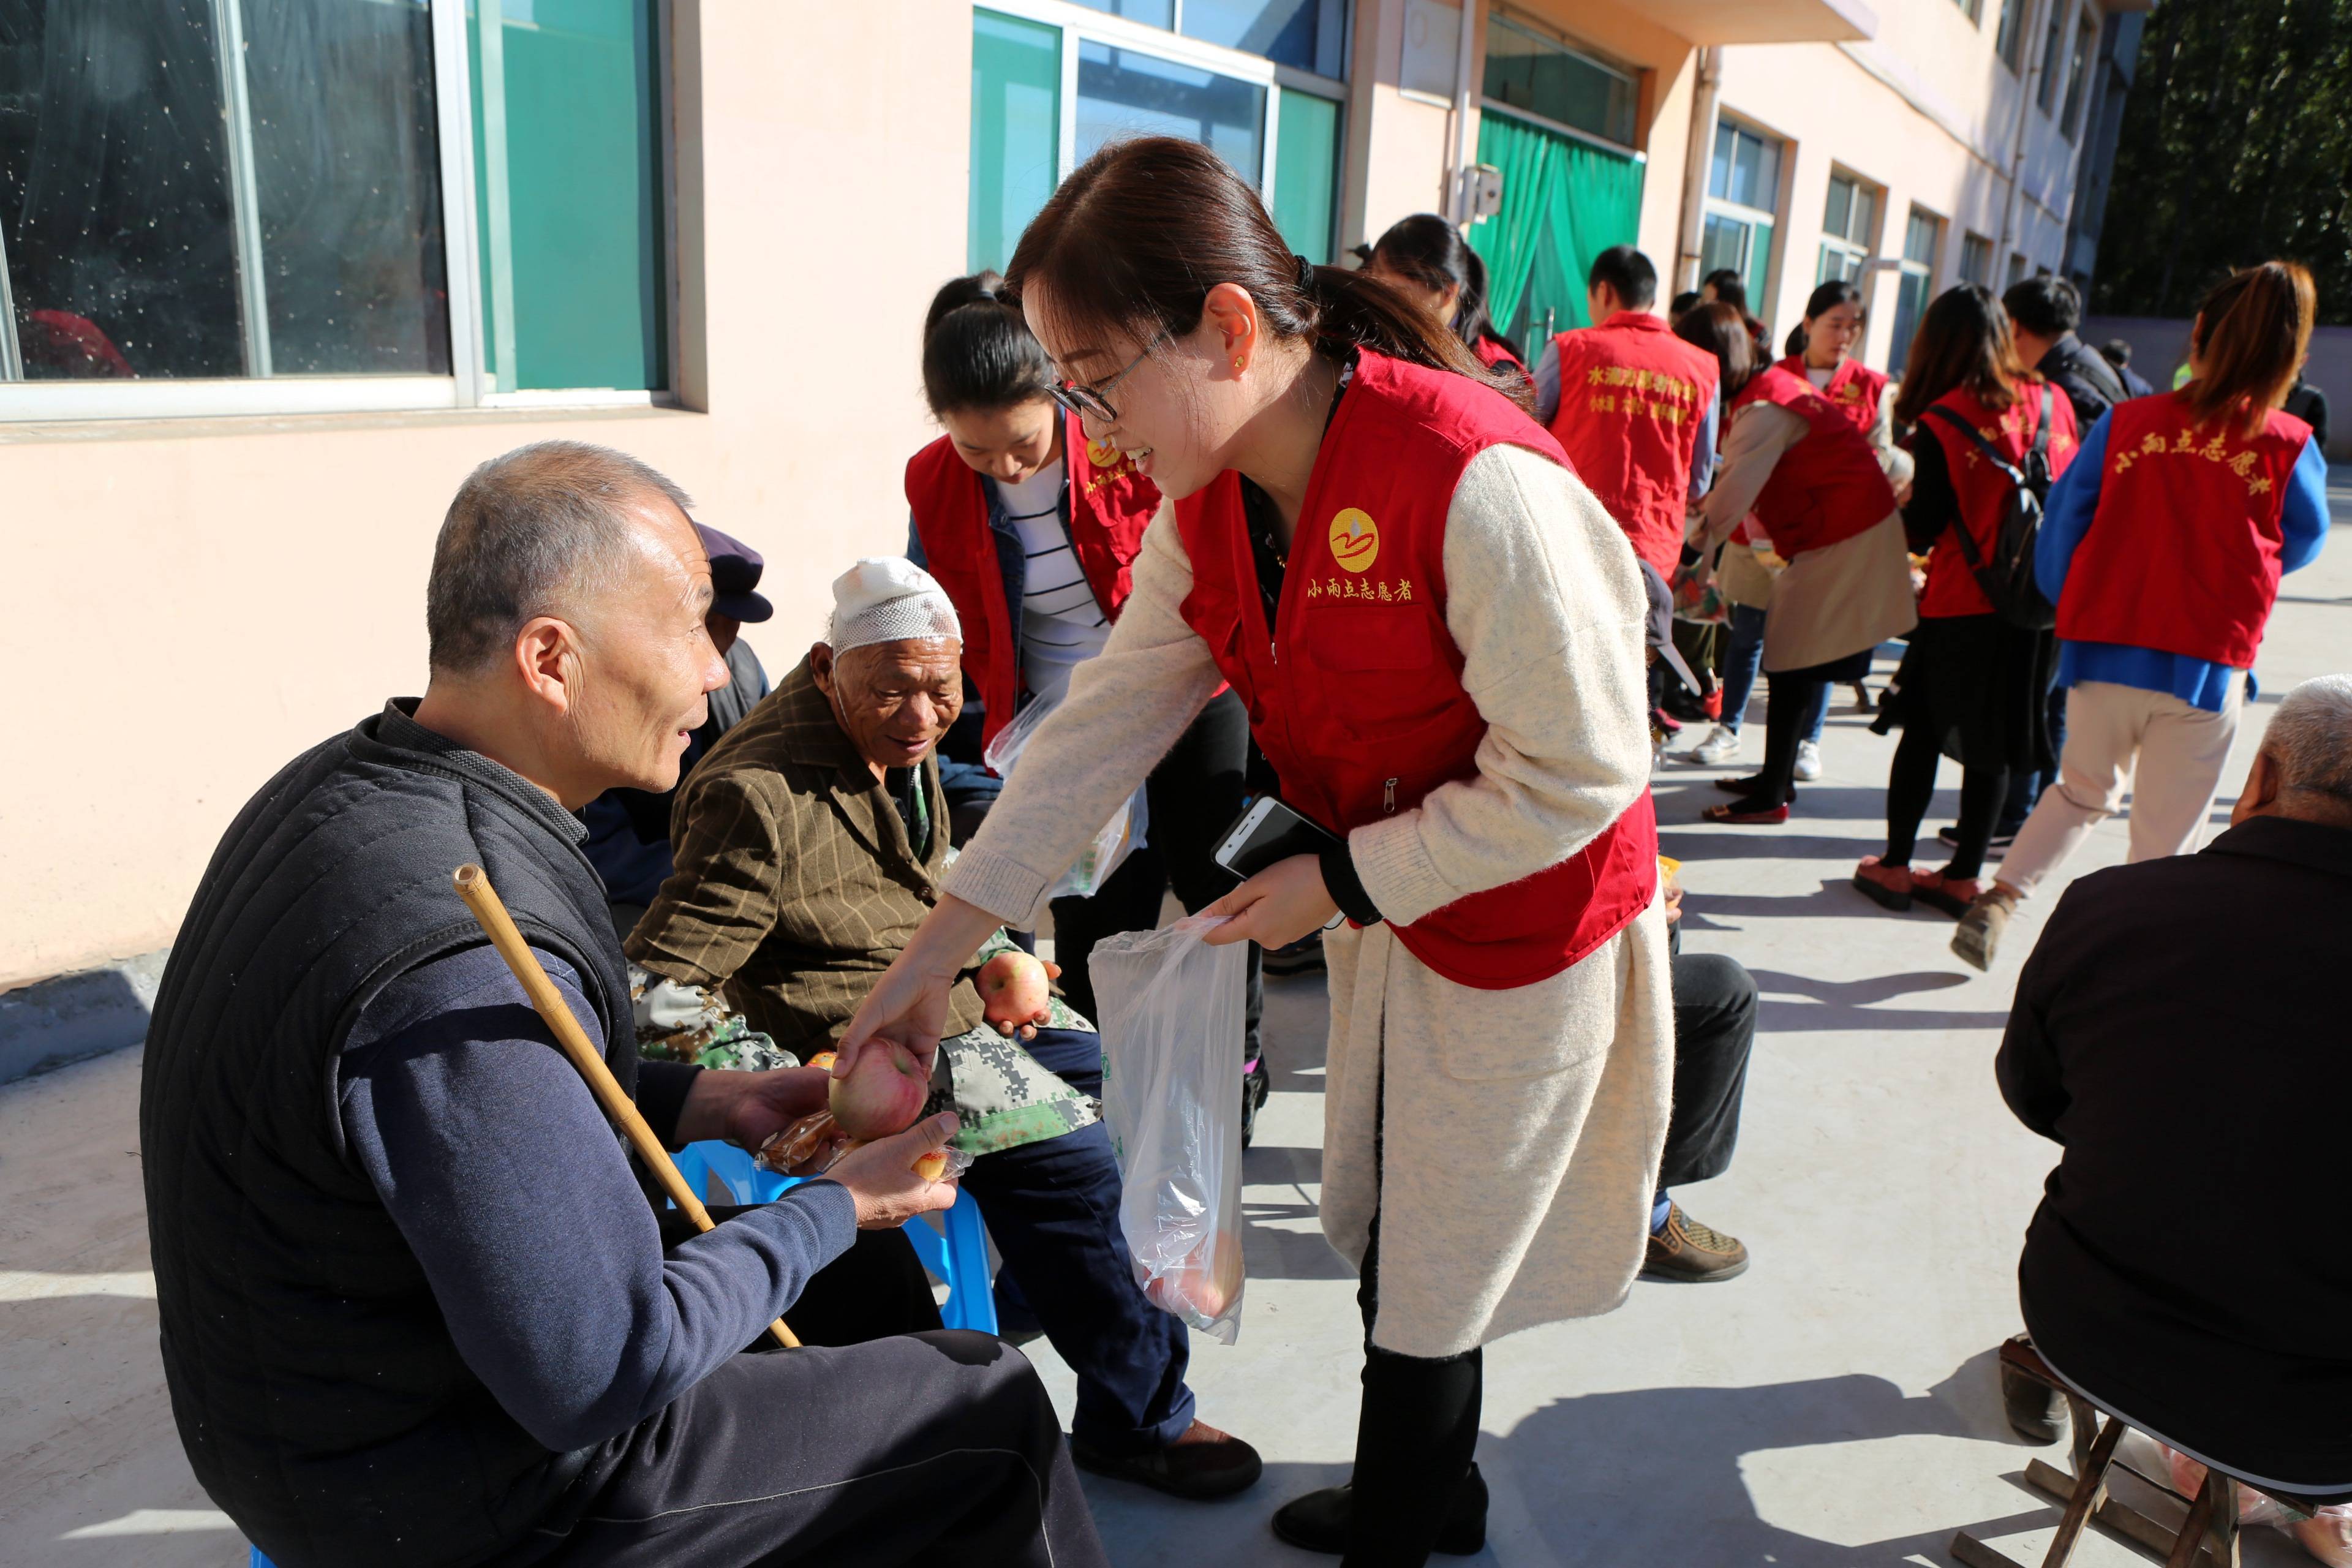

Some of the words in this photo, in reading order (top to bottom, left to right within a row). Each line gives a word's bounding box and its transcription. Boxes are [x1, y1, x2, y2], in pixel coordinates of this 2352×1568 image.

[2114, 428, 2273, 496] 小雨点志愿者
[1307, 578, 1412, 602] 小雨点志愿者
